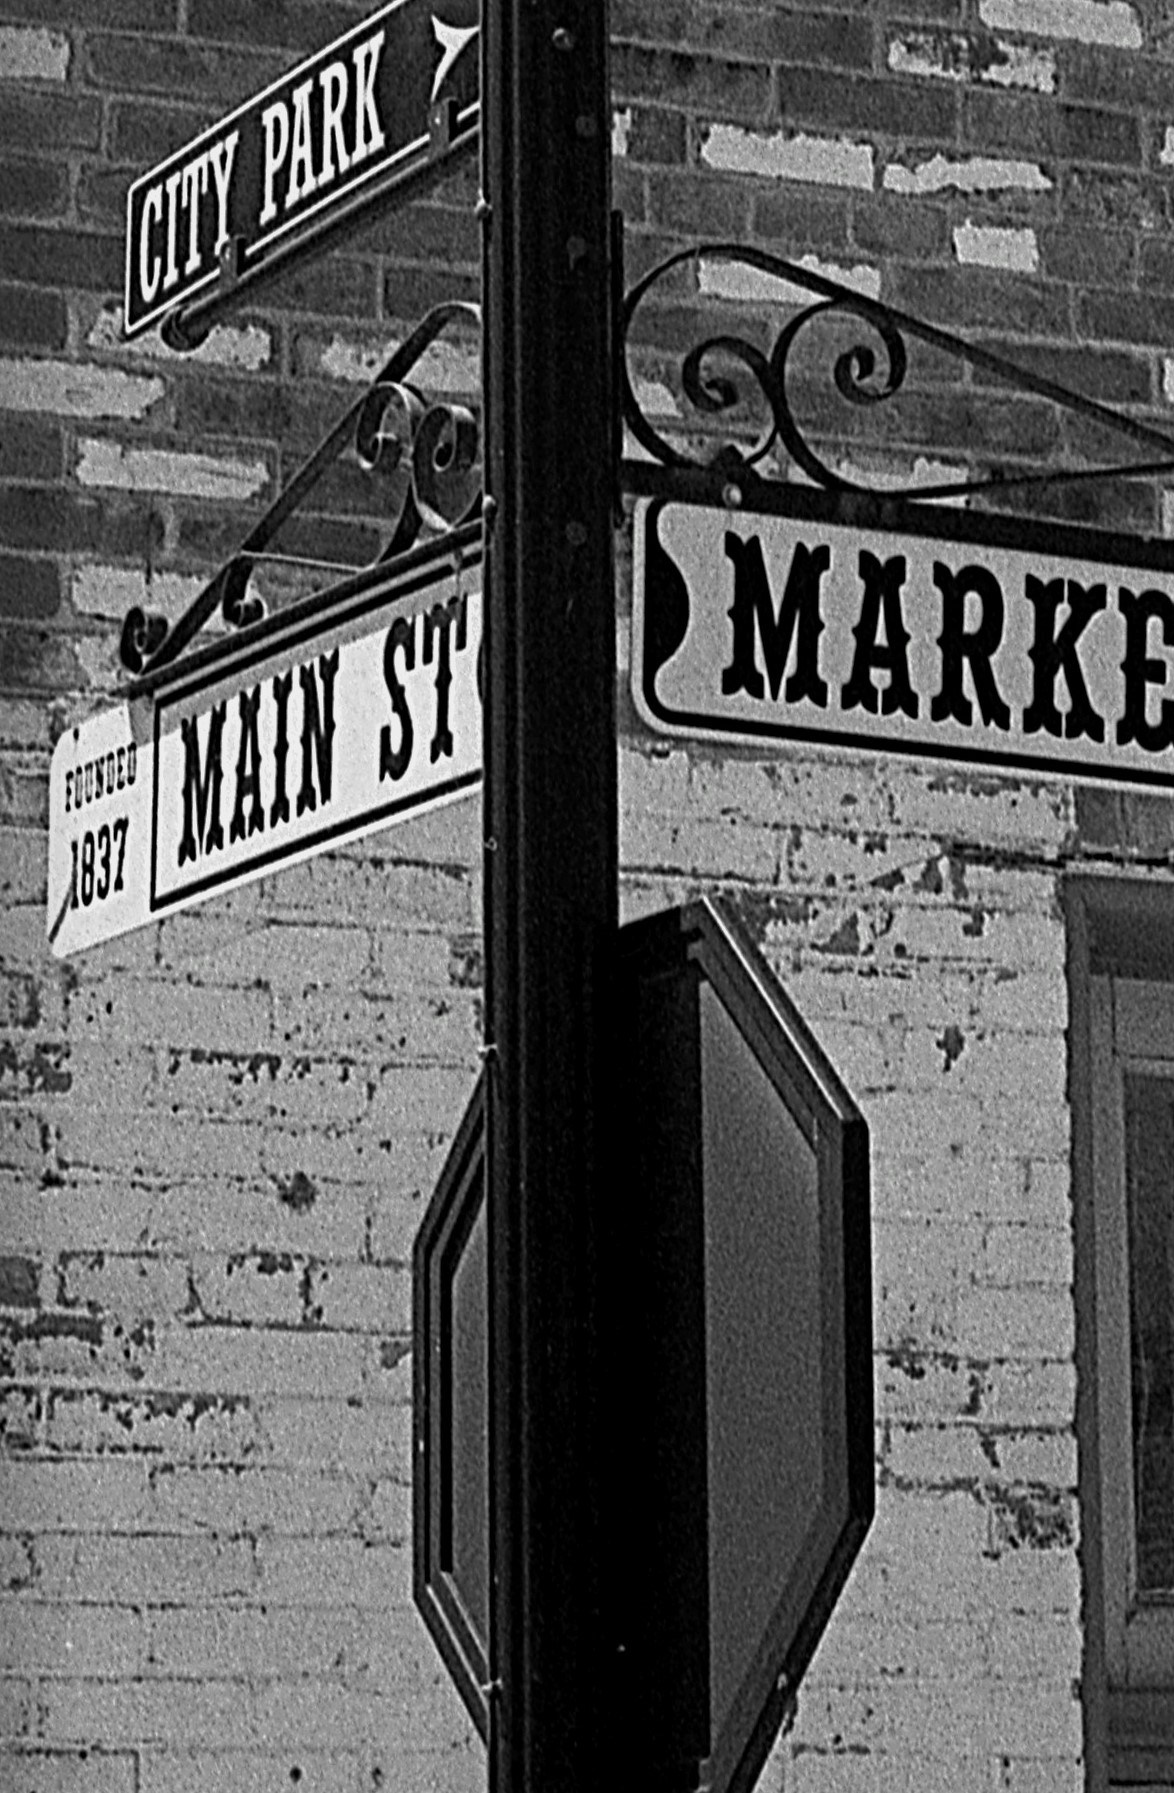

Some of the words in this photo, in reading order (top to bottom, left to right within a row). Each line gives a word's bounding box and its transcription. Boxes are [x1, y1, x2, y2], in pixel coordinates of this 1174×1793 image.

[138, 129, 241, 303] CITY
[259, 28, 386, 227] PARK
[64, 739, 139, 814] FOUNDED
[177, 645, 341, 868] MAIN
[378, 591, 470, 784] ST
[70, 816, 130, 911] 1837
